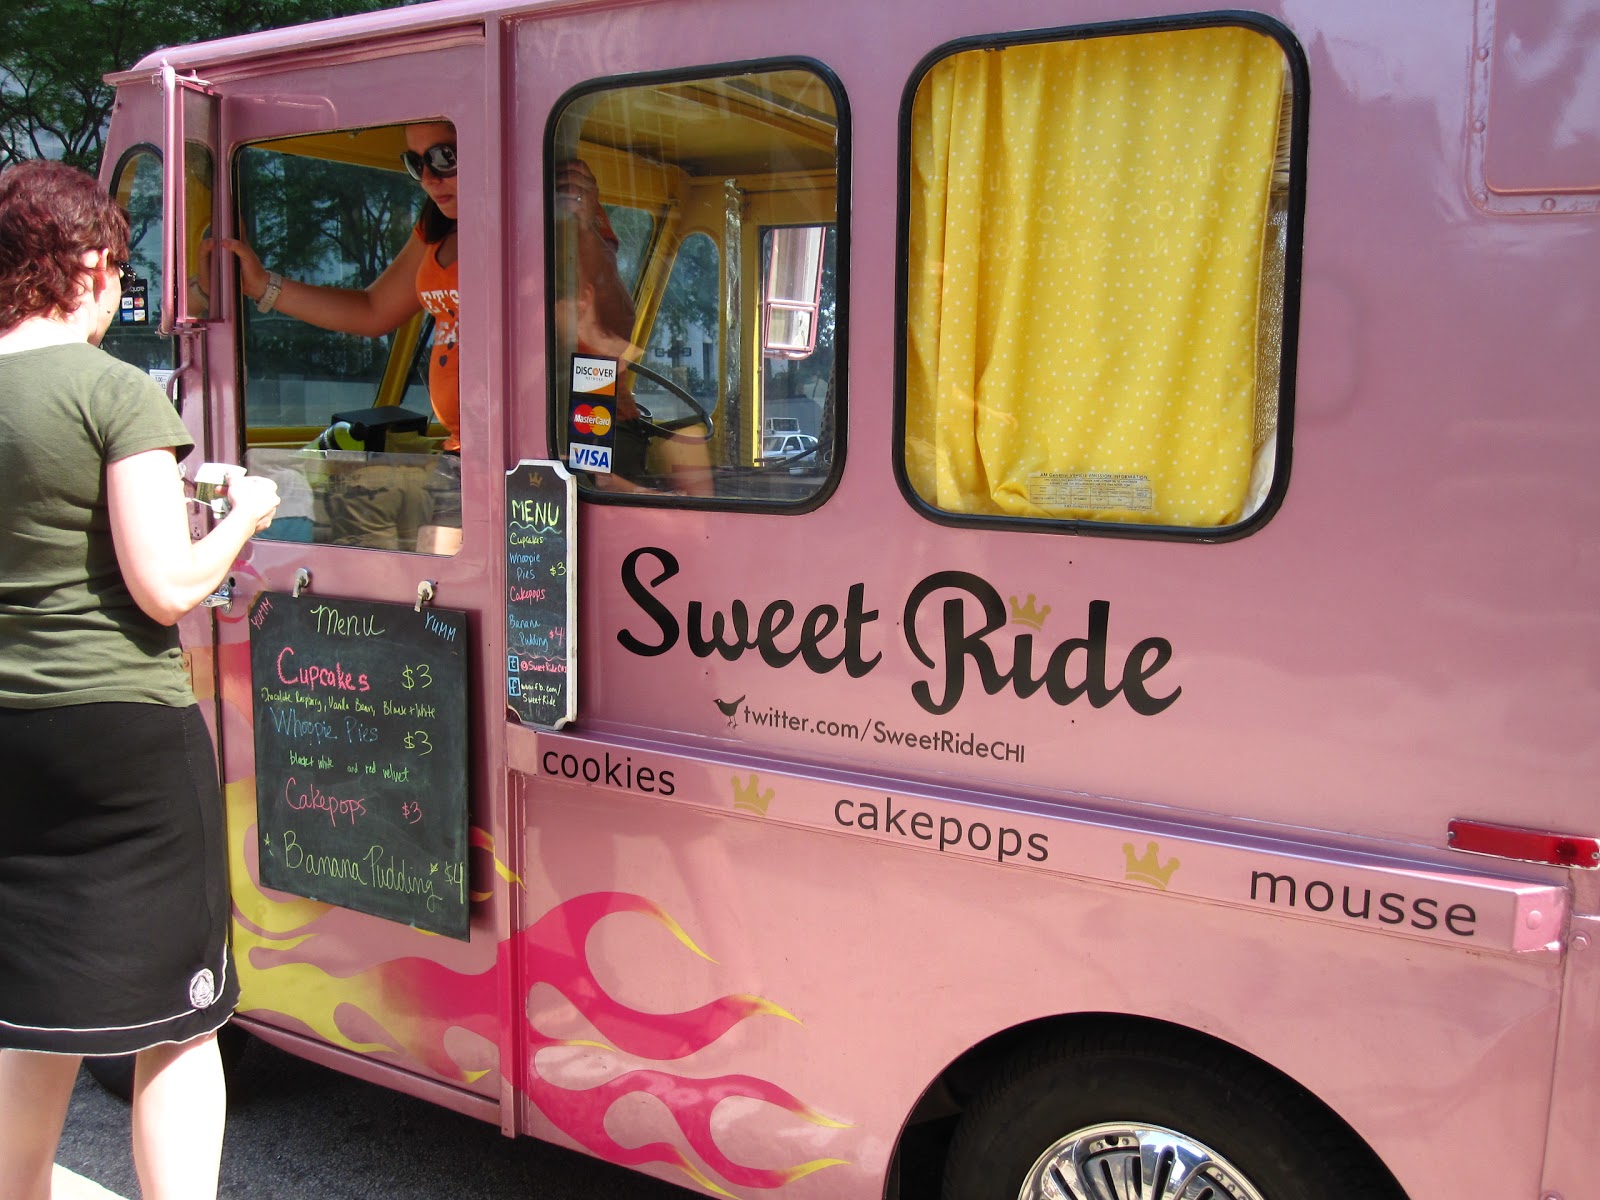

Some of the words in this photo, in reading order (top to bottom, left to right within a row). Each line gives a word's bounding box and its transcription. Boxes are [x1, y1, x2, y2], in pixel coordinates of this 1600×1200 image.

[575, 365, 614, 378] DISCOVER
[574, 413, 612, 427] MasterCard
[572, 447, 609, 469] VISA
[511, 499, 560, 526] MENU
[509, 552, 541, 566] Whoopie
[516, 566, 536, 581] Pies
[549, 561, 567, 576] $3
[310, 604, 386, 636] Menu
[518, 631, 549, 652] Pudding
[549, 627, 565, 647] $4
[616, 546, 883, 679] Sweet
[903, 570, 1183, 717] Ride
[276, 646, 371, 692] Cupcakes
[401, 664, 433, 691] $3
[269, 706, 338, 745] Whoopie
[344, 715, 379, 744] Pies
[403, 730, 433, 756] $3
[743, 703, 1026, 764] twitter.com/SweetRideCHI
[365, 760, 377, 774] red
[541, 748, 677, 796] cookies
[285, 777, 367, 828] Cakepops
[402, 801, 422, 825] $3
[833, 796, 1051, 863] cakepops
[284, 830, 368, 886] Banana
[363, 845, 443, 913] Pudding
[1249, 869, 1478, 938] mousse
